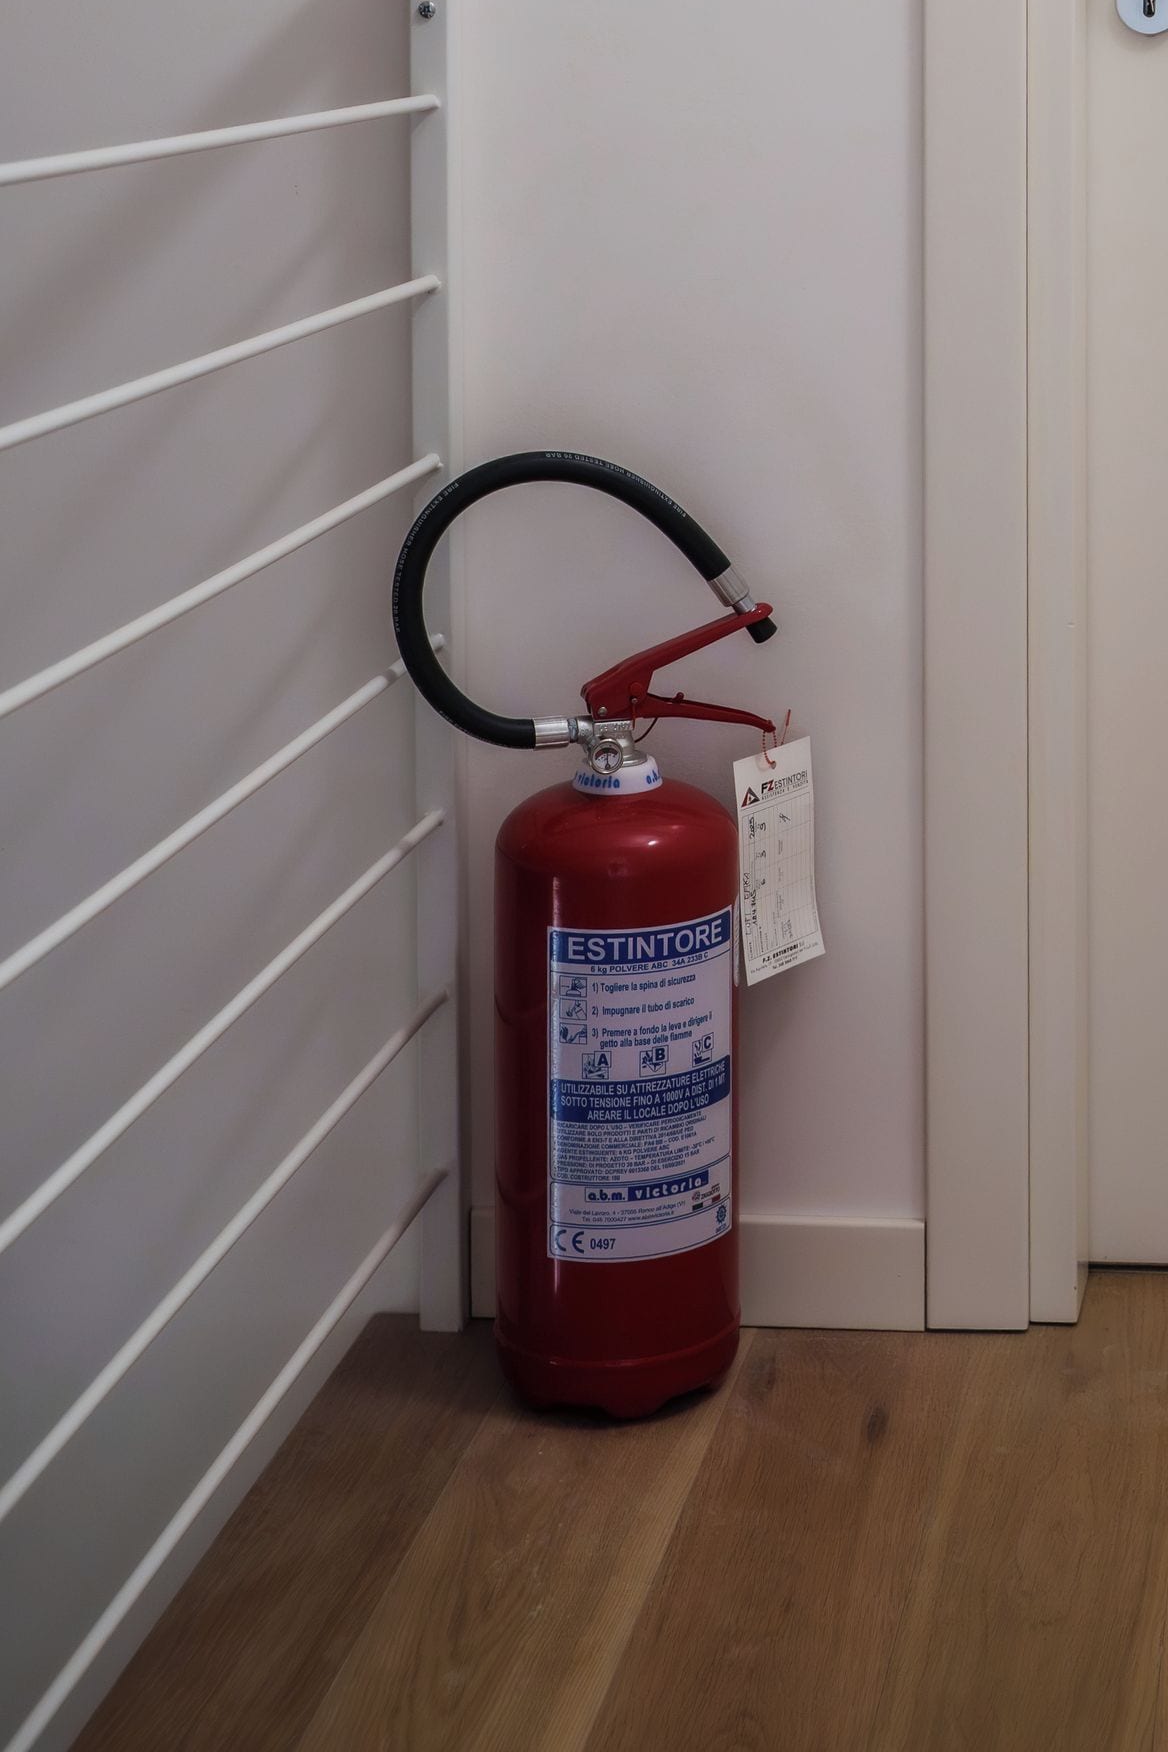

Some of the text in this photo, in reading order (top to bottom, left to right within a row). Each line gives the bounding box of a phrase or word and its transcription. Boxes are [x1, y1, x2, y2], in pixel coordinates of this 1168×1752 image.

[442, 481, 460, 497] FIRE
[567, 919, 722, 961] ESTINTORE
[598, 964, 607, 975] kg
[609, 963, 649, 973] POLVERE
[651, 960, 668, 970] ABC
[671, 958, 686, 967] 34A
[600, 982, 630, 994] Togliere
[639, 979, 658, 992] spina
[659, 978, 666, 988] di
[667, 974, 696, 987] sicurezza
[602, 1005, 640, 1017] Impugnare
[647, 1003, 664, 1013] tubo
[664, 1000, 671, 1010] di
[672, 997, 695, 1009] scarico
[602, 1027, 632, 1038] Premere
[639, 1025, 660, 1036] fondo
[668, 1021, 682, 1032] leva
[600, 1030, 692, 1048] getto alla base delle fiamme
[703, 1036, 712, 1049] C
[597, 1053, 609, 1066] A
[655, 1048, 665, 1061] B
[561, 1061, 725, 1095] UTILIZZABILE SU ATTREZZATURE ELETTRICHE
[560, 1095, 587, 1107] SOTTO
[590, 1096, 631, 1108] TENSIONE
[633, 1094, 653, 1106] FINO
[654, 1094, 661, 1104] A
[663, 1089, 684, 1102] 1000V
[684, 1088, 691, 1098] A
[691, 1083, 708, 1096] DIST.
[587, 1094, 709, 1121] AREARE IL LOCALE DOPO L'USO
[588, 1189, 626, 1201] a.b.m.
[635, 1178, 702, 1199] victoria
[590, 1238, 616, 1250] 0497
